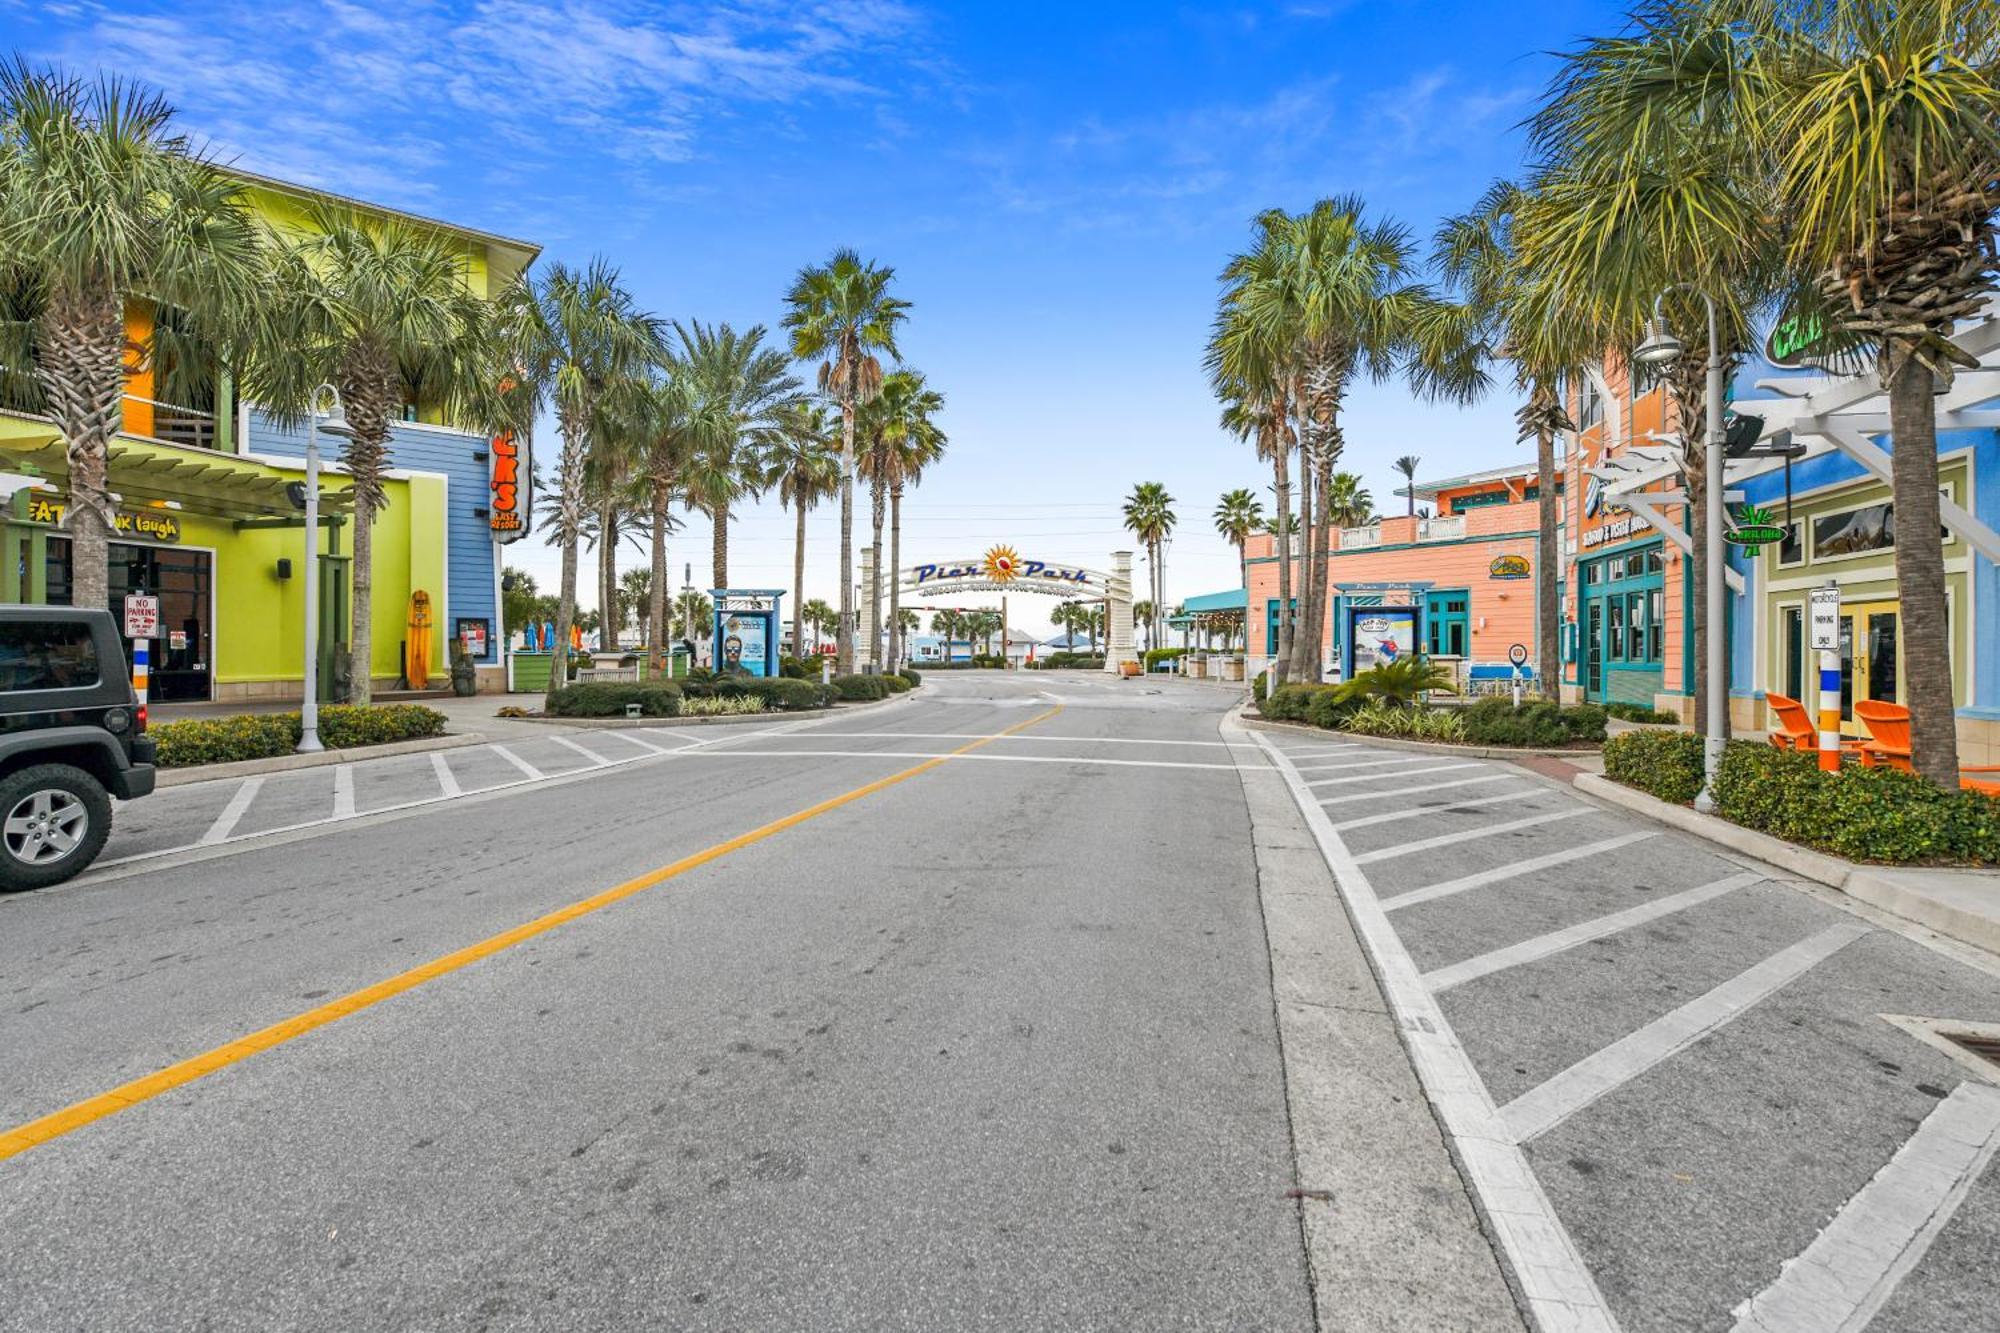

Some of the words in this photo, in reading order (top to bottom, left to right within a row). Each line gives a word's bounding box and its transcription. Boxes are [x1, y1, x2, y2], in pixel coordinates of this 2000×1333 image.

[136, 516, 176, 540] laugh
[913, 564, 986, 583] Pier
[1024, 561, 1092, 584] Park
[136, 600, 149, 608] NO
[128, 608, 156, 617] PARKING
